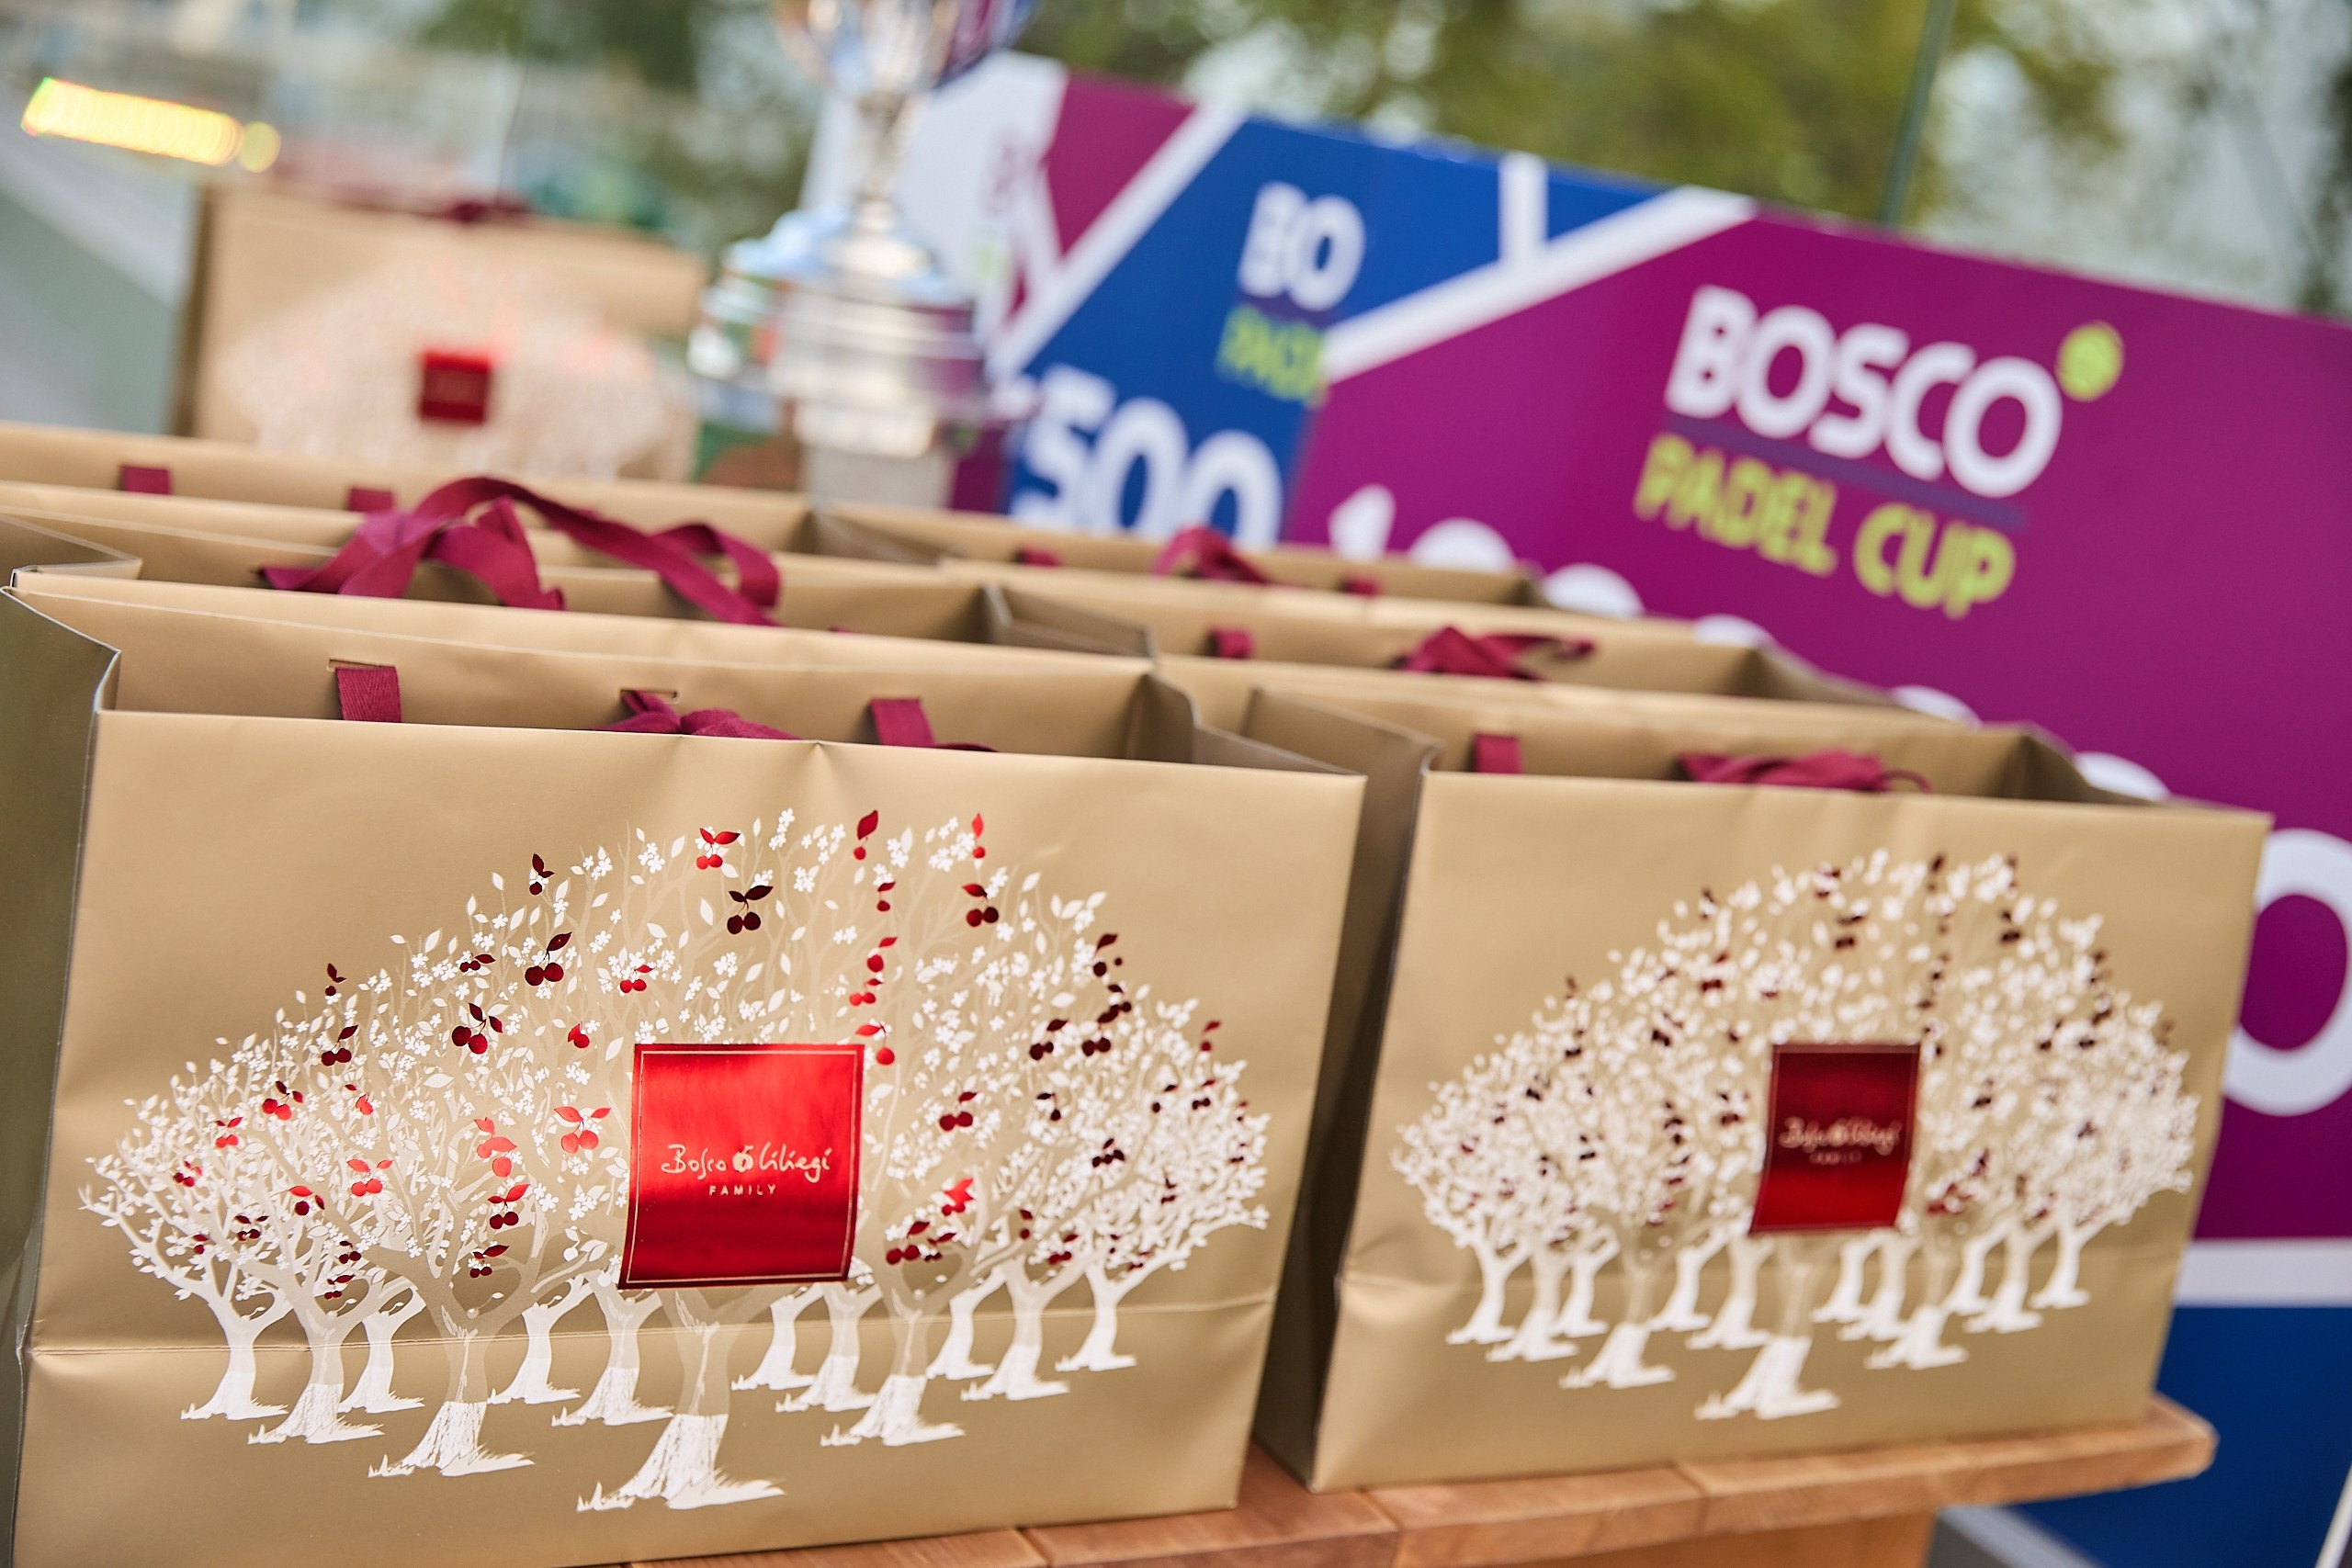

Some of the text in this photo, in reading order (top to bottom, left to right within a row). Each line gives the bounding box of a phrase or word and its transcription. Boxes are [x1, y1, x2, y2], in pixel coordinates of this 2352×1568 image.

[1665, 284, 2063, 498] BOSCO
[1634, 433, 1838, 578] PADEL
[1851, 502, 2017, 621] CUP
[661, 1144, 728, 1180] Bosco
[708, 1184, 776, 1196] FAMILY
